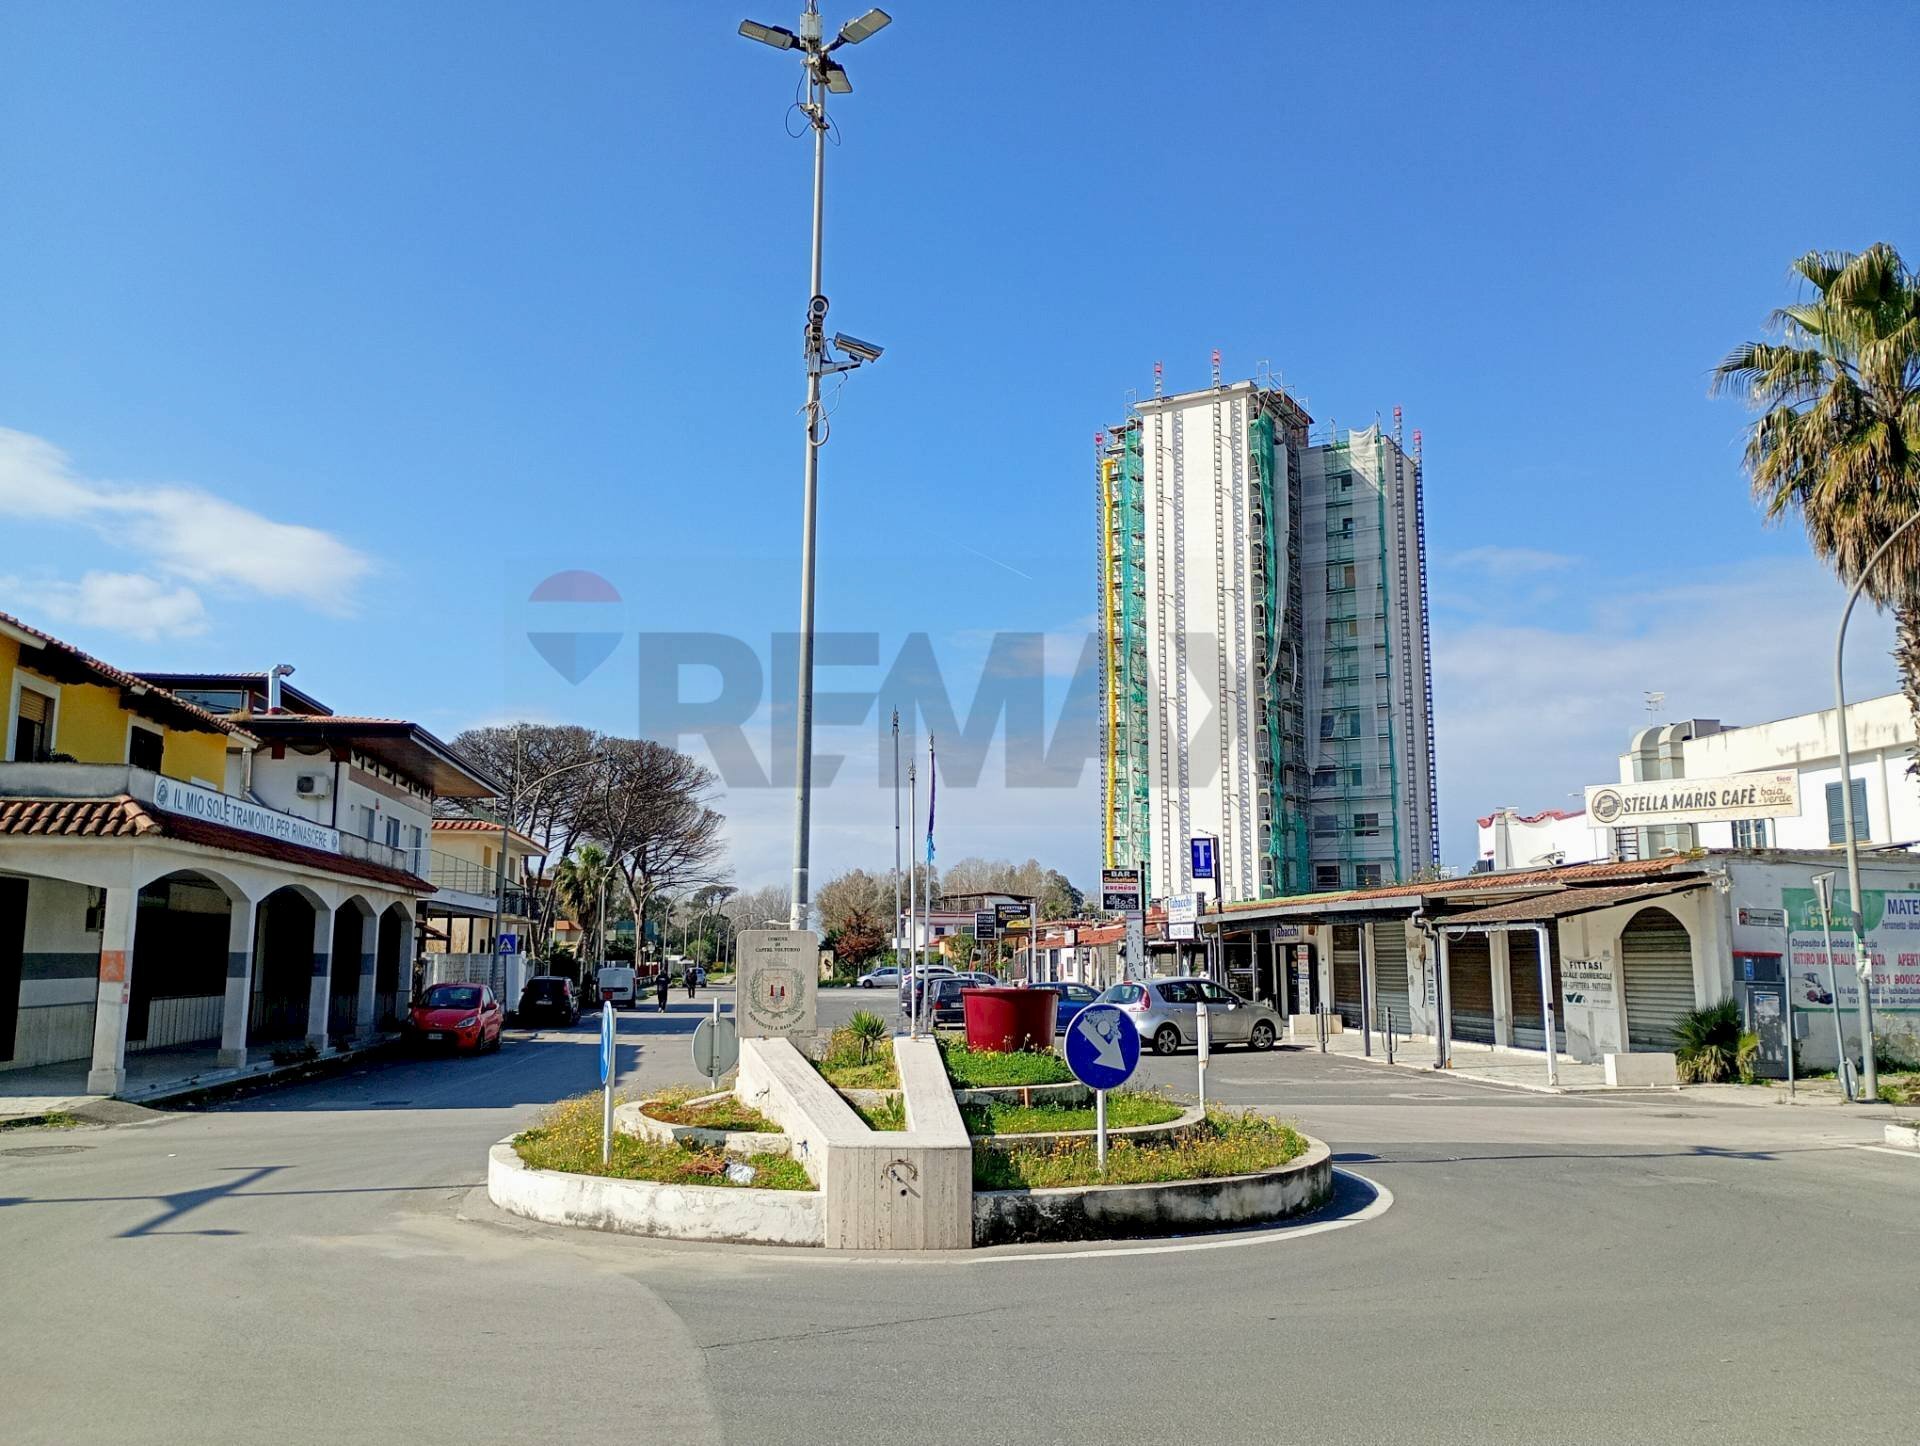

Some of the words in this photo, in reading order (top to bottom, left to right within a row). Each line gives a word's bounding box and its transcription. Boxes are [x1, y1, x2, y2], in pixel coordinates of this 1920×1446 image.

[1760, 786, 1783, 796] baia
[1624, 794, 1668, 813] STELLA
[1672, 791, 1717, 810] MARIS
[1721, 784, 1757, 806] CAFÈ
[1763, 793, 1792, 803] verde
[173, 788, 184, 811] IL
[186, 793, 205, 816] MIO
[206, 797, 230, 823] SOLE
[232, 805, 276, 834] TRAMONTA
[275, 818, 290, 839] PER
[292, 823, 328, 848] RINASCERE
[1888, 899, 1920, 914] MATE
[1793, 953, 1815, 966] RITIRO
[1569, 961, 1602, 970] FITTASI
[1875, 974, 1890, 984] 331
